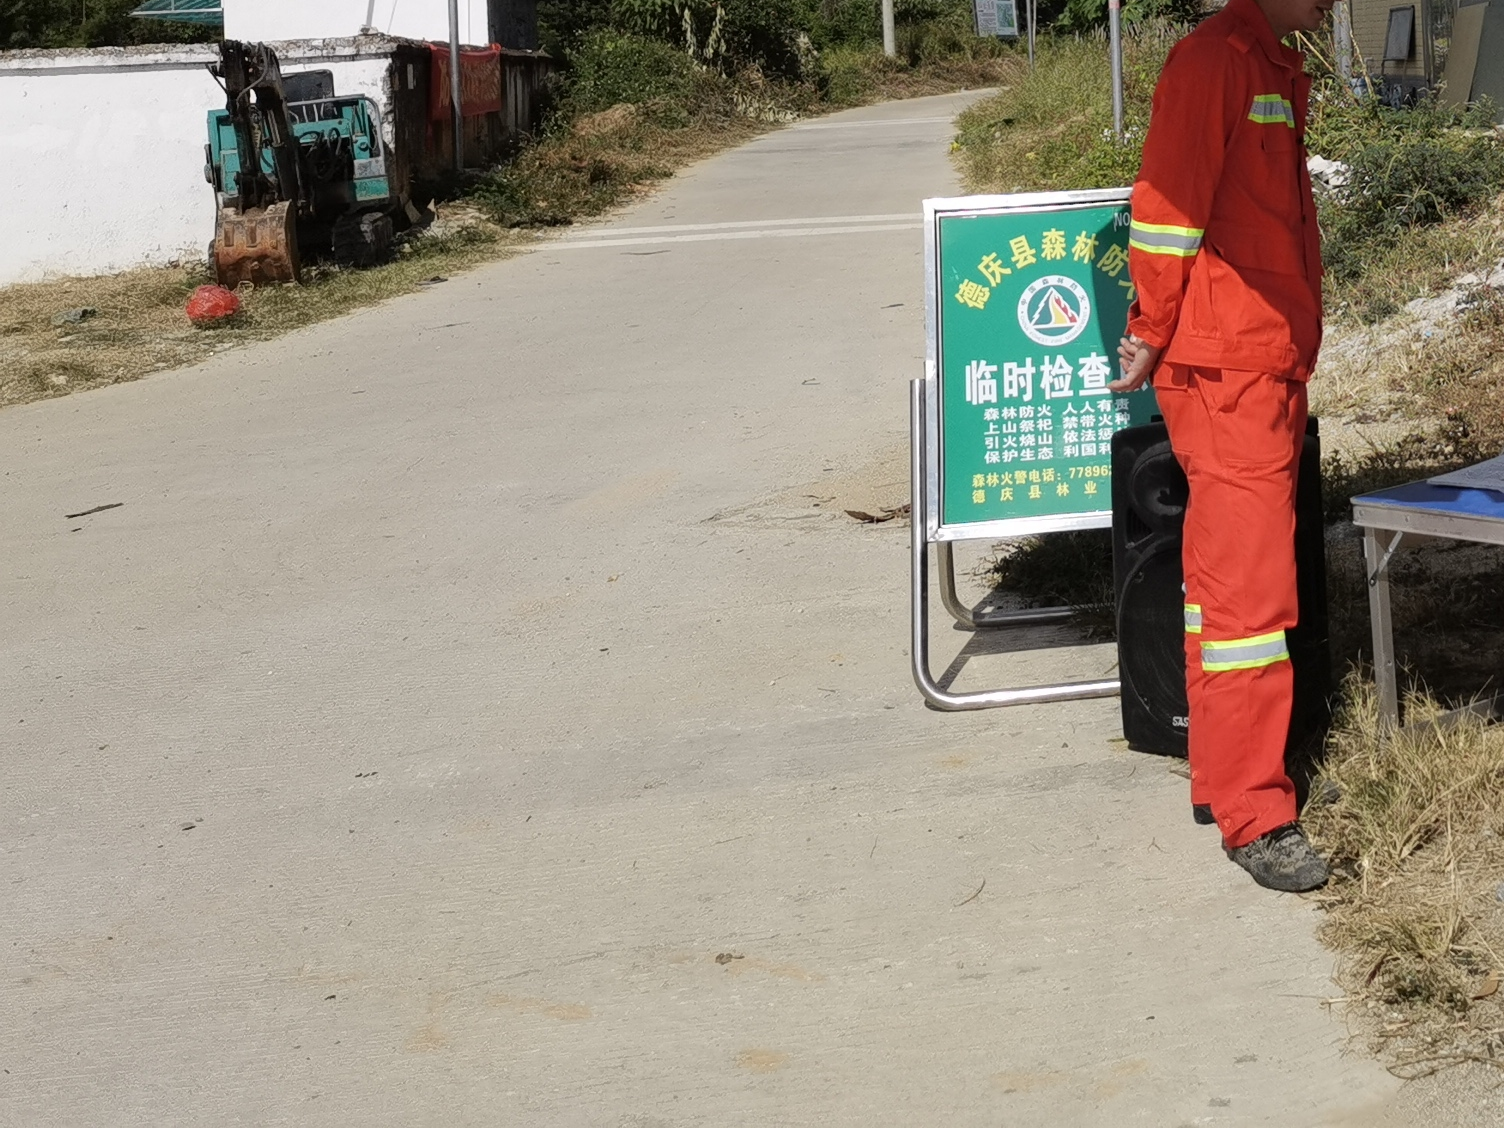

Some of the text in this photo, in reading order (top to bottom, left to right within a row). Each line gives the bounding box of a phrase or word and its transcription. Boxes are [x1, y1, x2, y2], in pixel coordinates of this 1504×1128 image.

[964, 351, 1149, 406] 临时检查
[983, 397, 1131, 422] 森林防火 人人有责
[983, 412, 1131, 436] 上山祭祀 禁带火种
[983, 426, 1128, 450] 引火烧山 依法惩
[983, 447, 1054, 465] 保护生态
